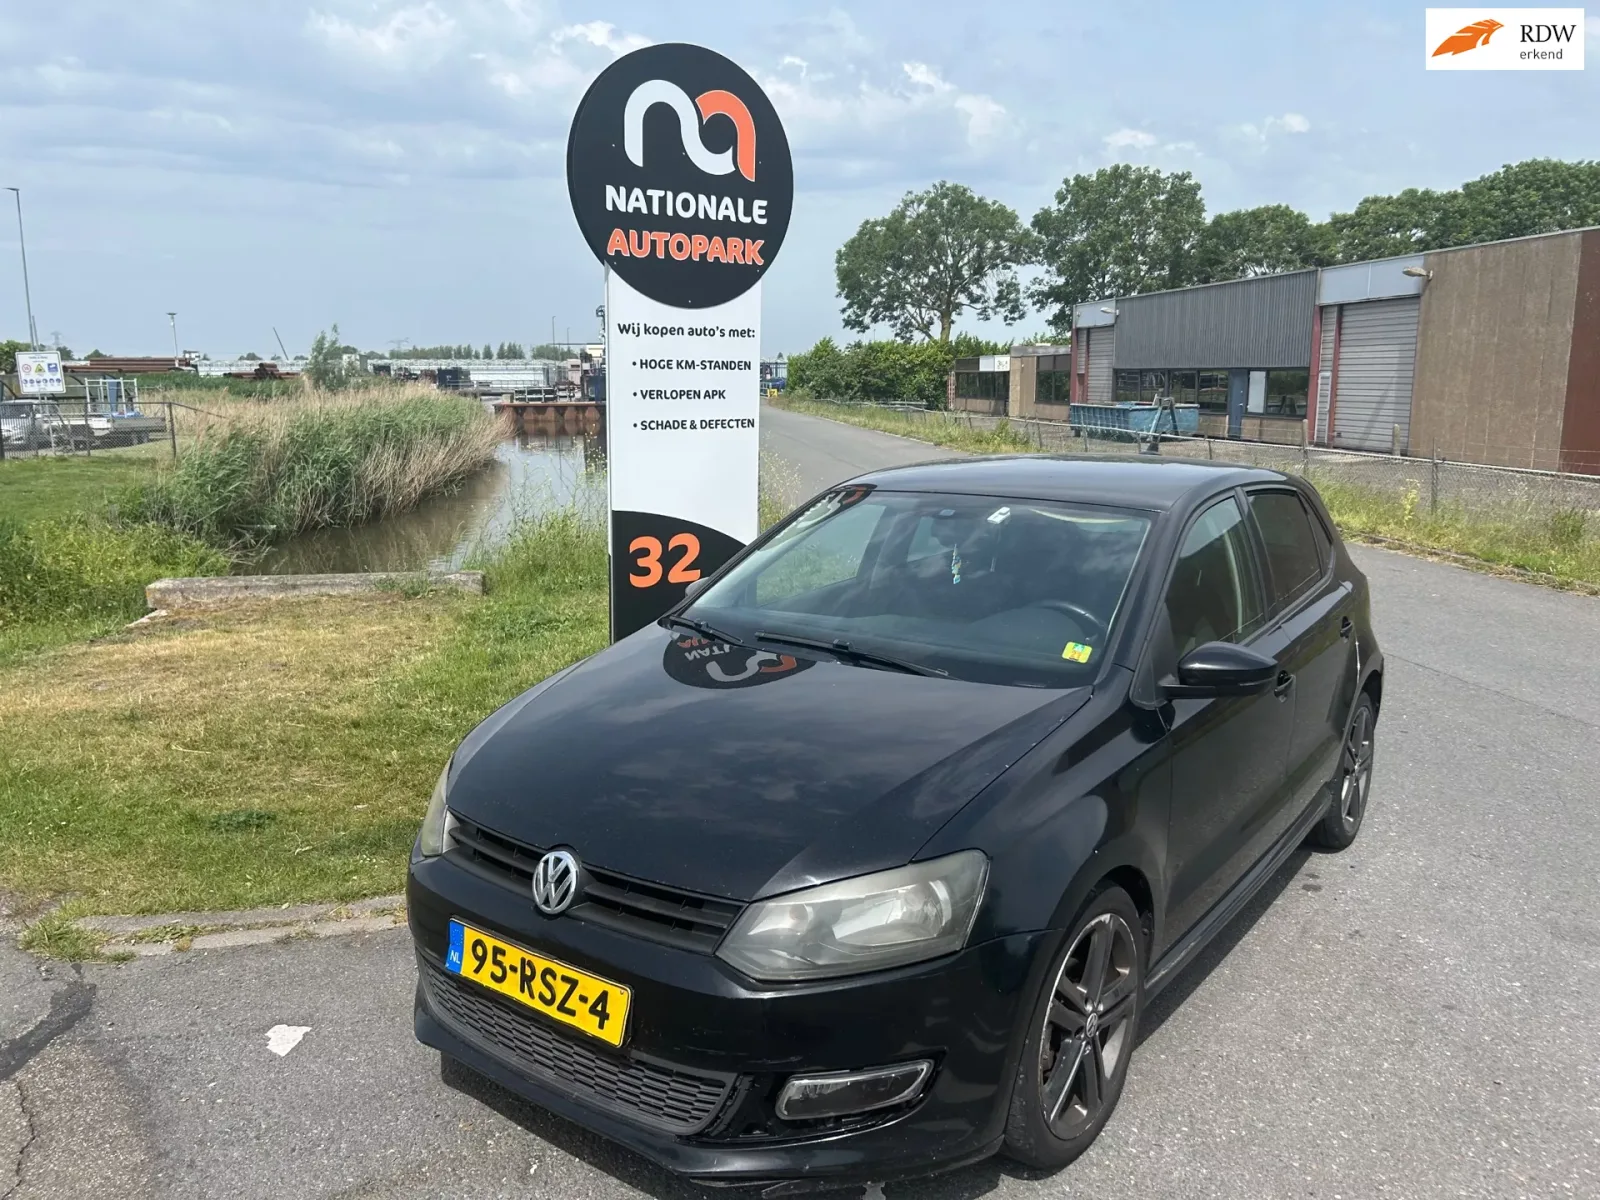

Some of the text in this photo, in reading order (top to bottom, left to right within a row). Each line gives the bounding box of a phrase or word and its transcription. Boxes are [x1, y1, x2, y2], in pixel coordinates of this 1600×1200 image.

[605, 184, 768, 225] NATIONALE
[606, 228, 765, 266] AUTOPARK
[617, 323, 756, 339] Wij kopen auto's met:
[639, 358, 752, 371] HOGE KM-STANDEN
[640, 389, 727, 400] VERLOPEN APK
[640, 418, 756, 431] SCHADE & DEFECTEN
[629, 532, 701, 588] 32
[449, 948, 461, 965] NL
[471, 938, 611, 1031] 95-RSZ-4
